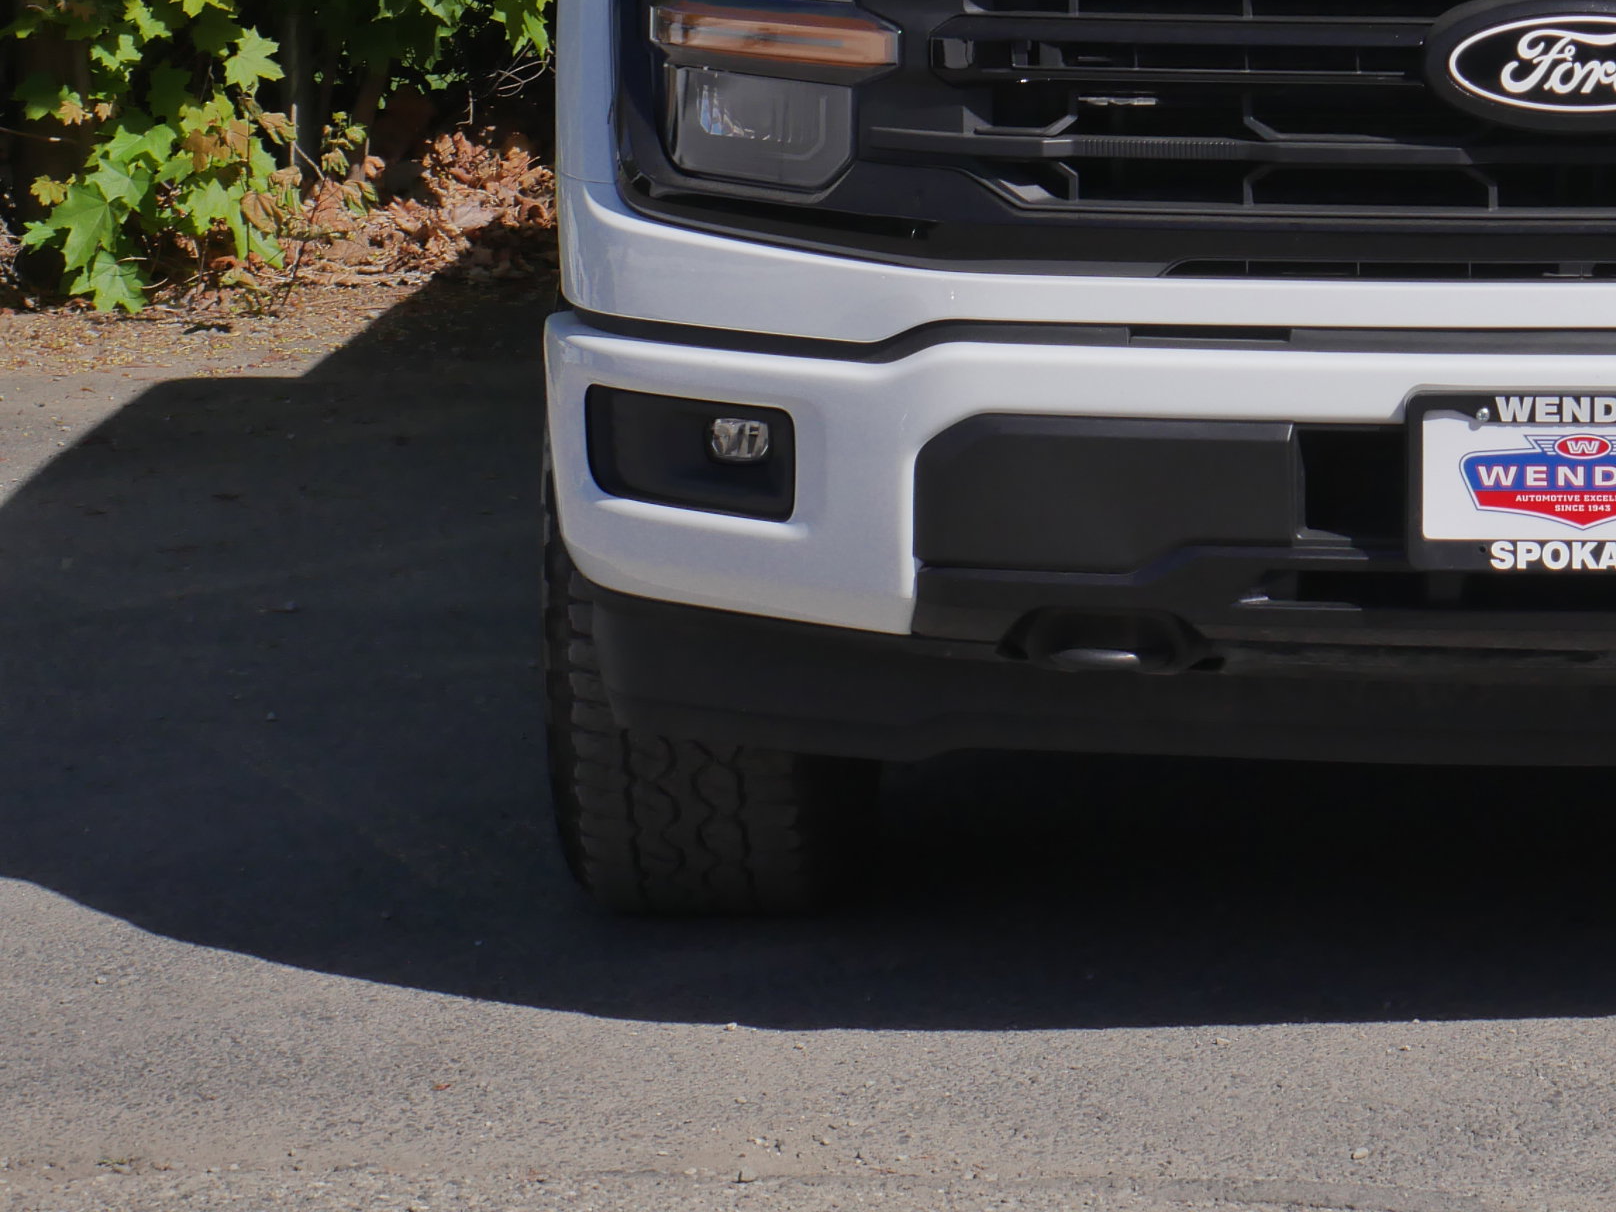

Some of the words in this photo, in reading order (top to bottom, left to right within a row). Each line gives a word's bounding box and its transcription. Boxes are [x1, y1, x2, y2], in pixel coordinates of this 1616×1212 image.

[1515, 494, 1580, 502] AUTOMOTIVE
[1554, 504, 1585, 512] SINCE
[1588, 504, 1611, 512] 1943
